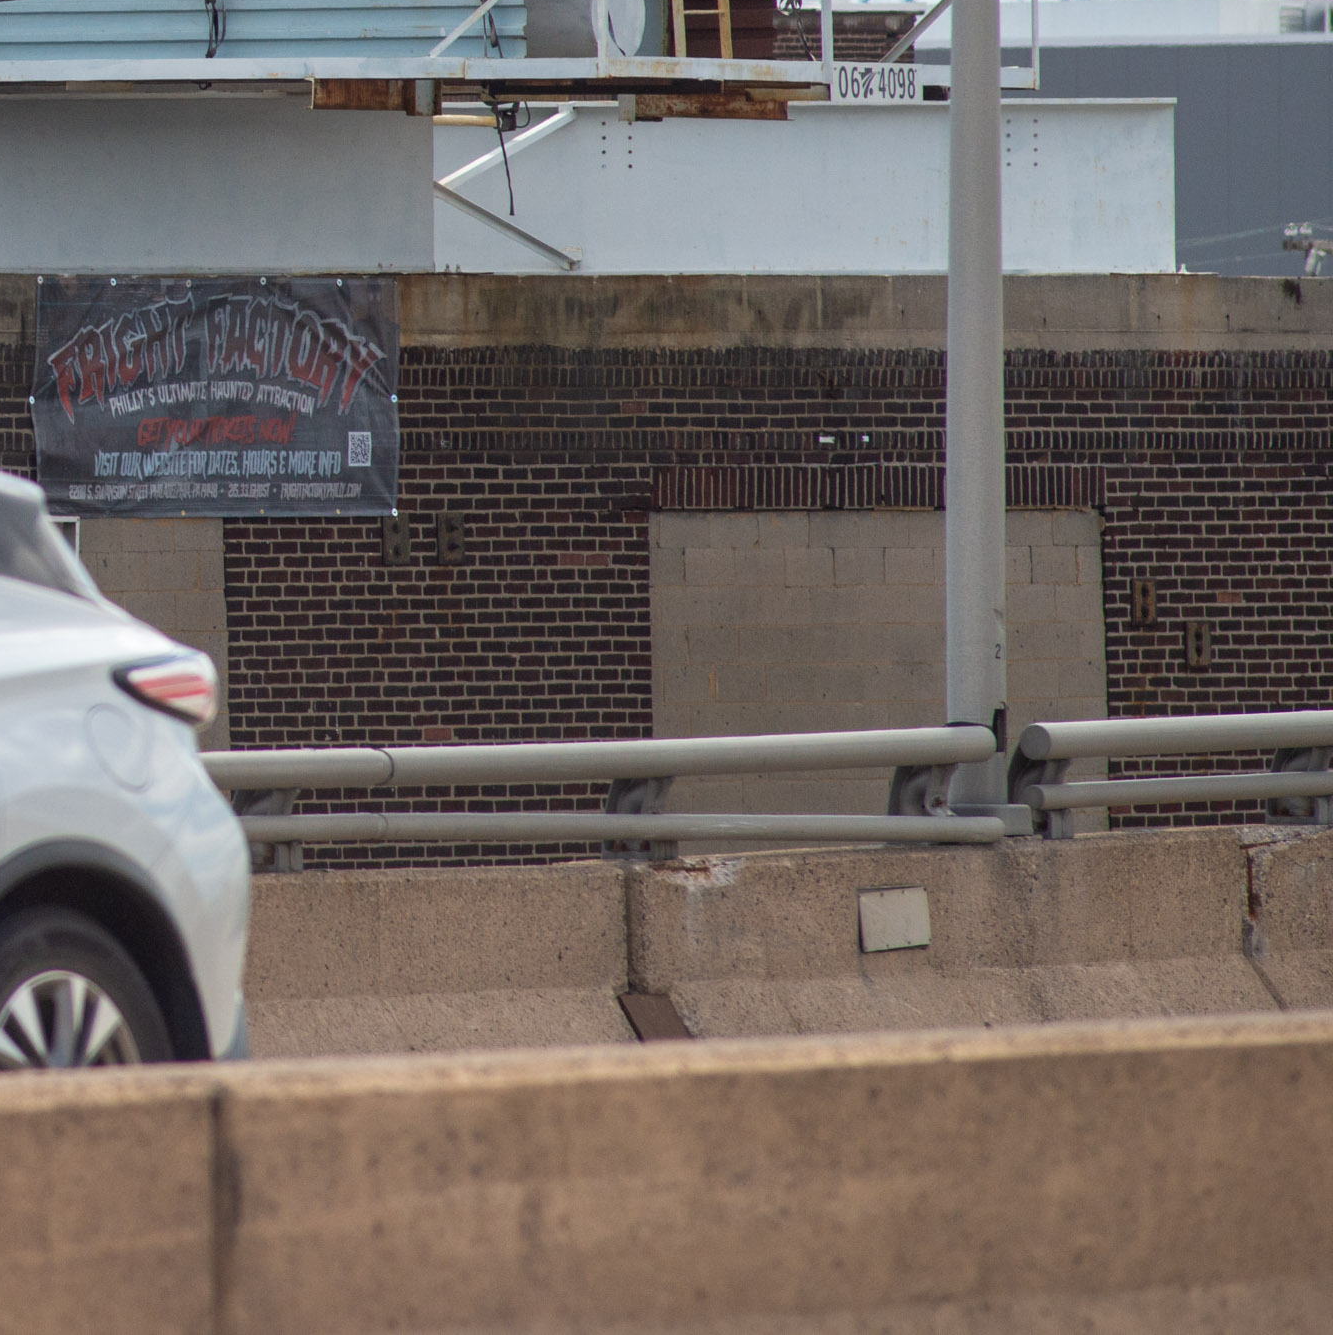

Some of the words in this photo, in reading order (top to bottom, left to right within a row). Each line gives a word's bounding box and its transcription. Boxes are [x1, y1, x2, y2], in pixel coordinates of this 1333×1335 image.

[838, 65, 861, 99] 06
[878, 66, 916, 100] 4098
[108, 387, 156, 418] PHILLY'S
[157, 381, 208, 404] ULTIMATE
[210, 380, 254, 402] HAUNTED
[256, 384, 315, 417] ATTRACTION
[137, 416, 167, 448] GET
[94, 449, 120, 478] VISIT
[120, 450, 144, 482] OUR
[143, 449, 188, 478] WEBSITE
[188, 450, 207, 480] FOR
[207, 450, 241, 477] DATES,
[241, 449, 278, 481] HOURS
[287, 450, 318, 481] MORE
[318, 450, 342, 480] INFO
[994, 643, 1002, 659] 2
